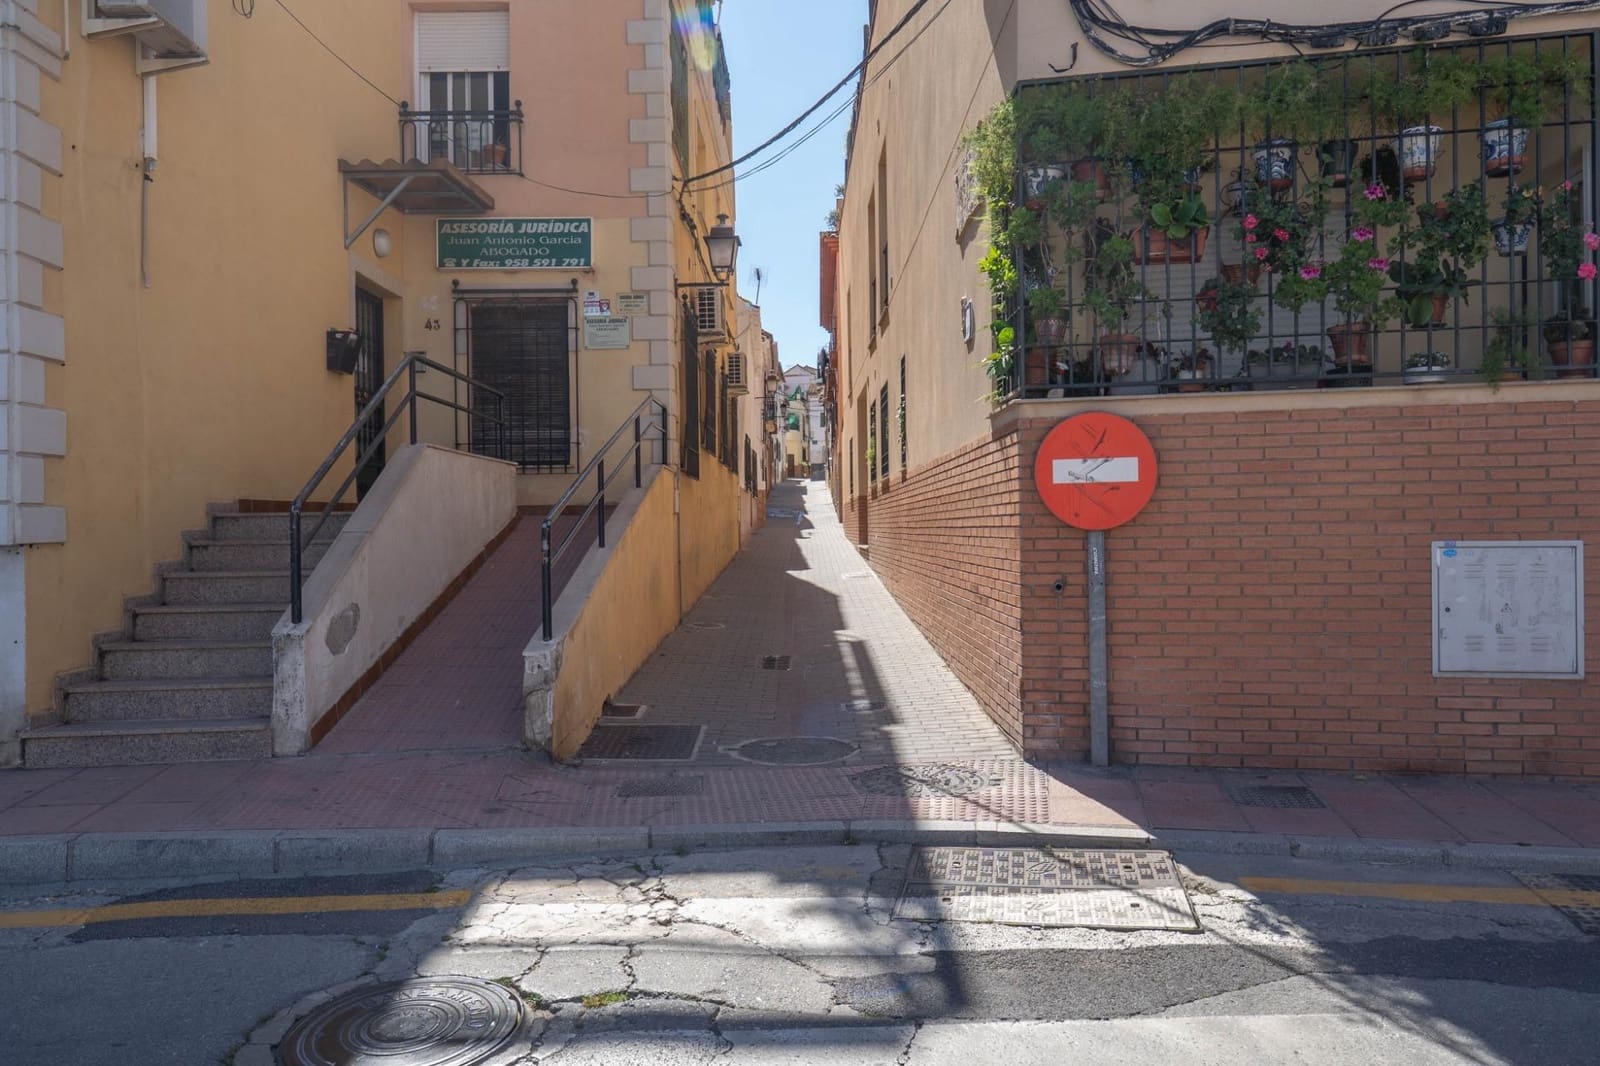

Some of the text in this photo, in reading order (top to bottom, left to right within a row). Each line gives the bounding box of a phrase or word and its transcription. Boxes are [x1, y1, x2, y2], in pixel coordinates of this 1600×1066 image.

[440, 220, 589, 233] ASESORÍA JURÍDICA
[447, 236, 479, 245] Juan
[483, 236, 536, 245] Antonio
[479, 247, 550, 256] ABOGADO
[461, 258, 470, 267] Y
[504, 258, 529, 267] 958
[532, 258, 557, 267] 591
[562, 258, 586, 266] 791
